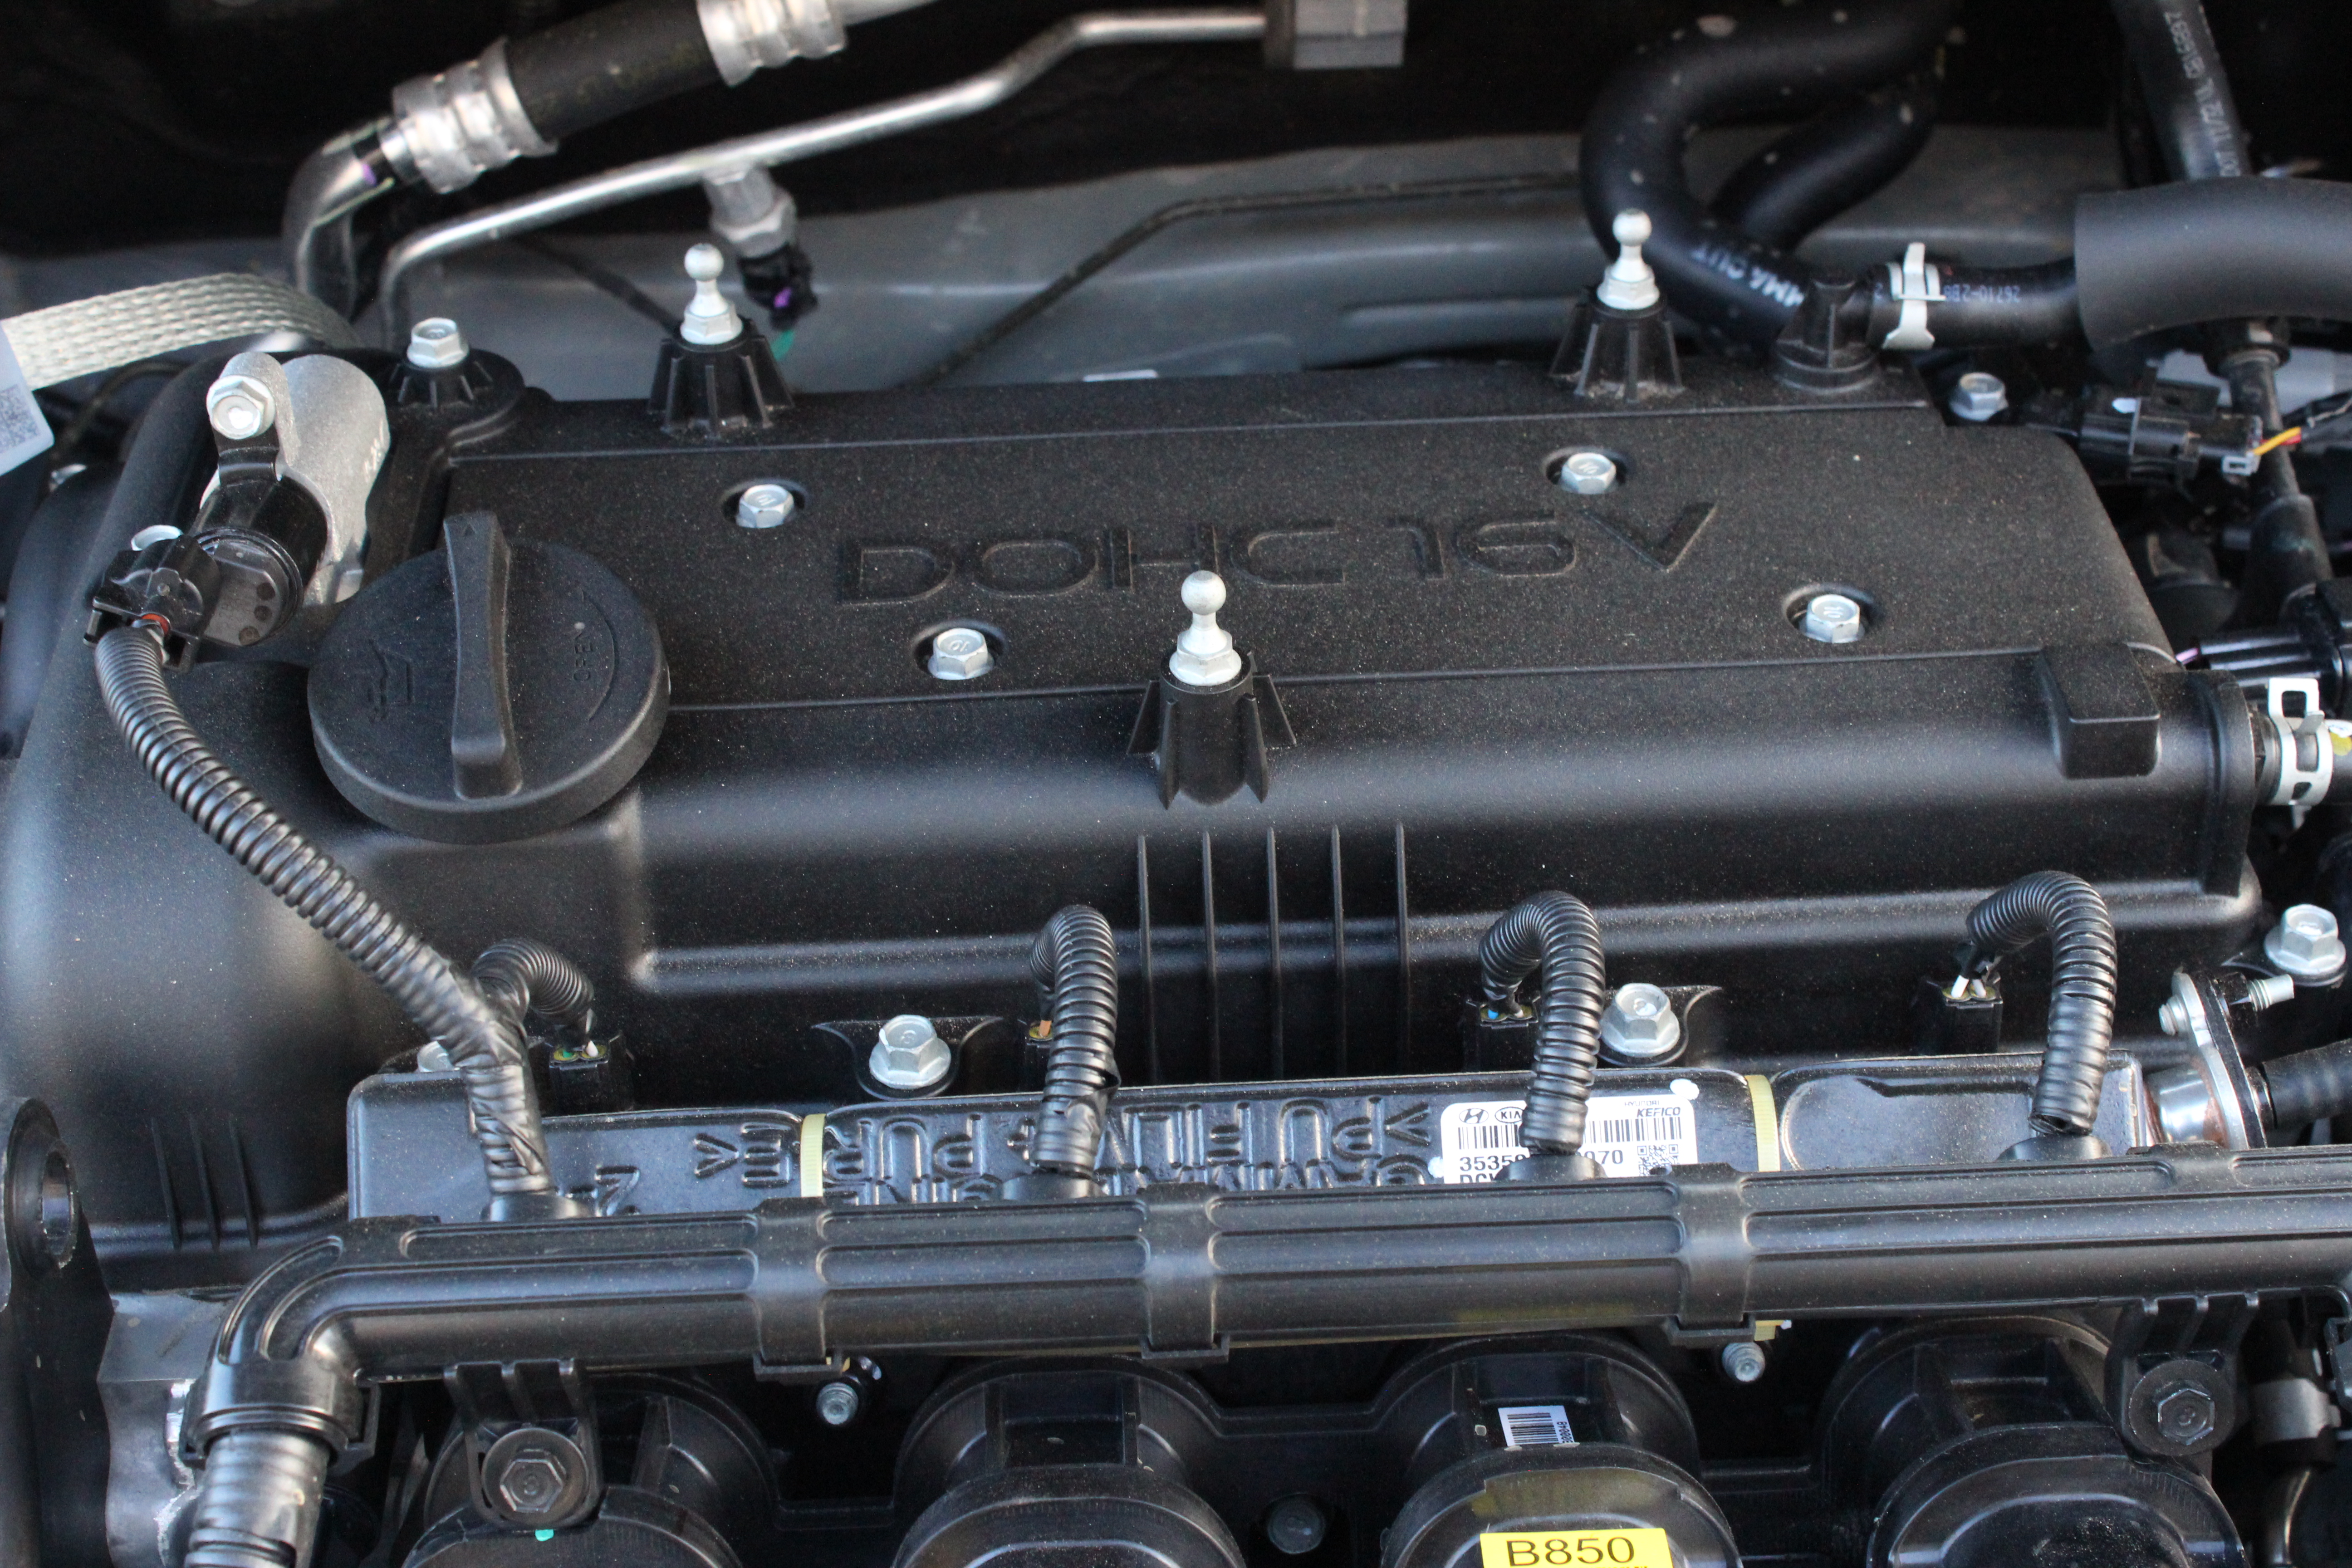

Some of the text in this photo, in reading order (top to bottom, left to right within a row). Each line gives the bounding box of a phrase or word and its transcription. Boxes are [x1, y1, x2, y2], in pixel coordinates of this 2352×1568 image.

[838, 502, 1720, 605] DOHC 16V
[1500, 1110, 1521, 1119] KIA
[1637, 1107, 1681, 1117] KEFICO
[1506, 1536, 1635, 1566] B850
